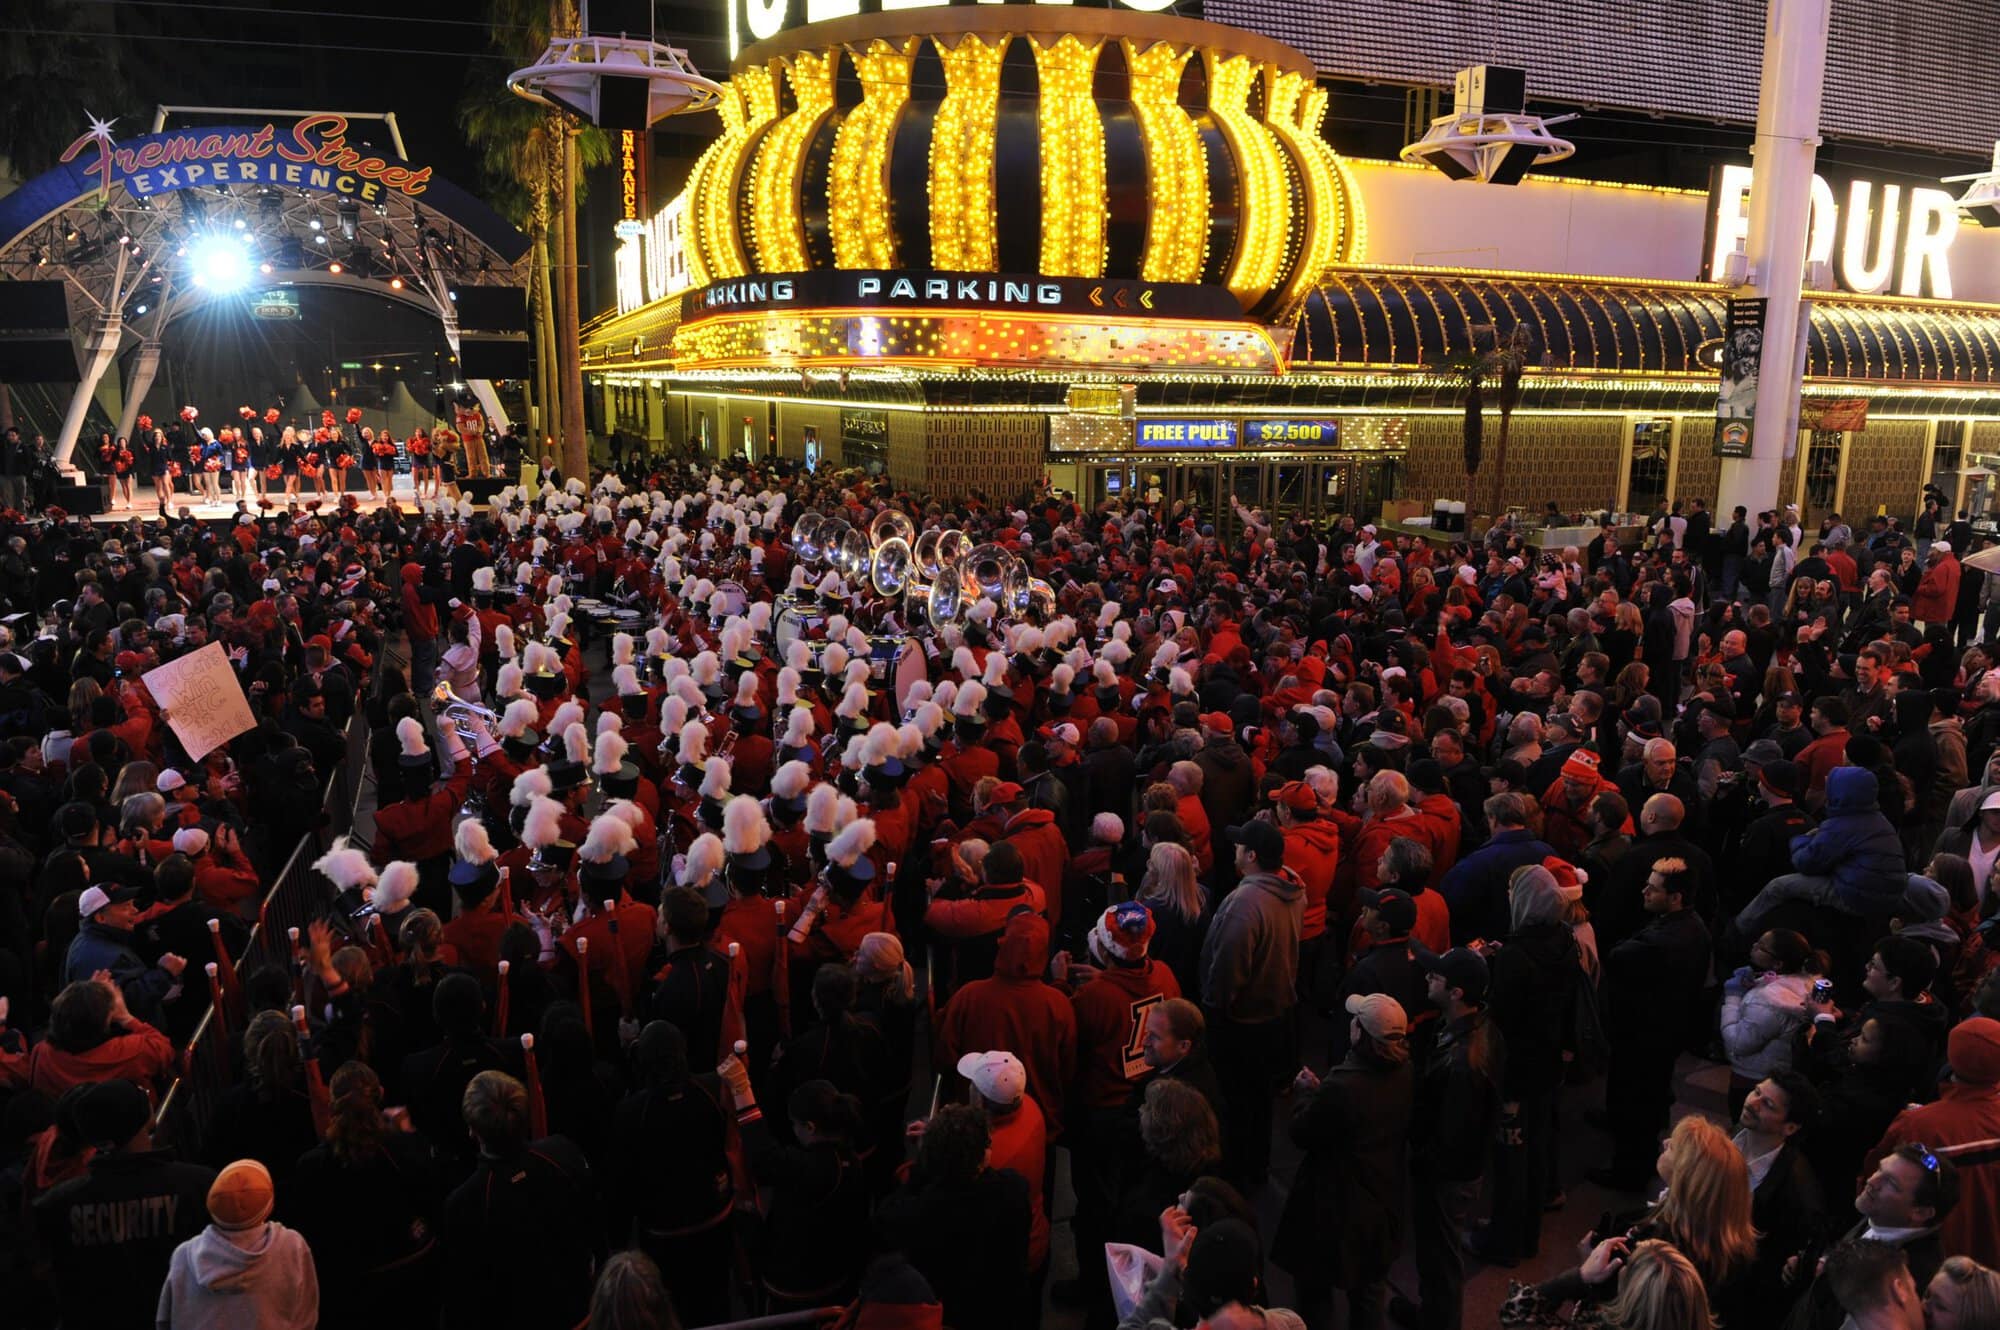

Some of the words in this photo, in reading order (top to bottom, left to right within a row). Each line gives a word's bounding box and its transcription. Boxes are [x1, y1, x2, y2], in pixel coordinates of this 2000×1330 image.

[60, 123, 274, 201] Fremont
[276, 113, 433, 195] Street
[622, 130, 636, 219] NTRANCE
[134, 161, 380, 201] EXPERIENCE
[858, 277, 1062, 304] PARKING
[1143, 424, 1186, 441] FREE
[1189, 424, 1230, 441] PULL
[1261, 424, 1322, 442] $2,500
[70, 1193, 179, 1249] SECURITY
